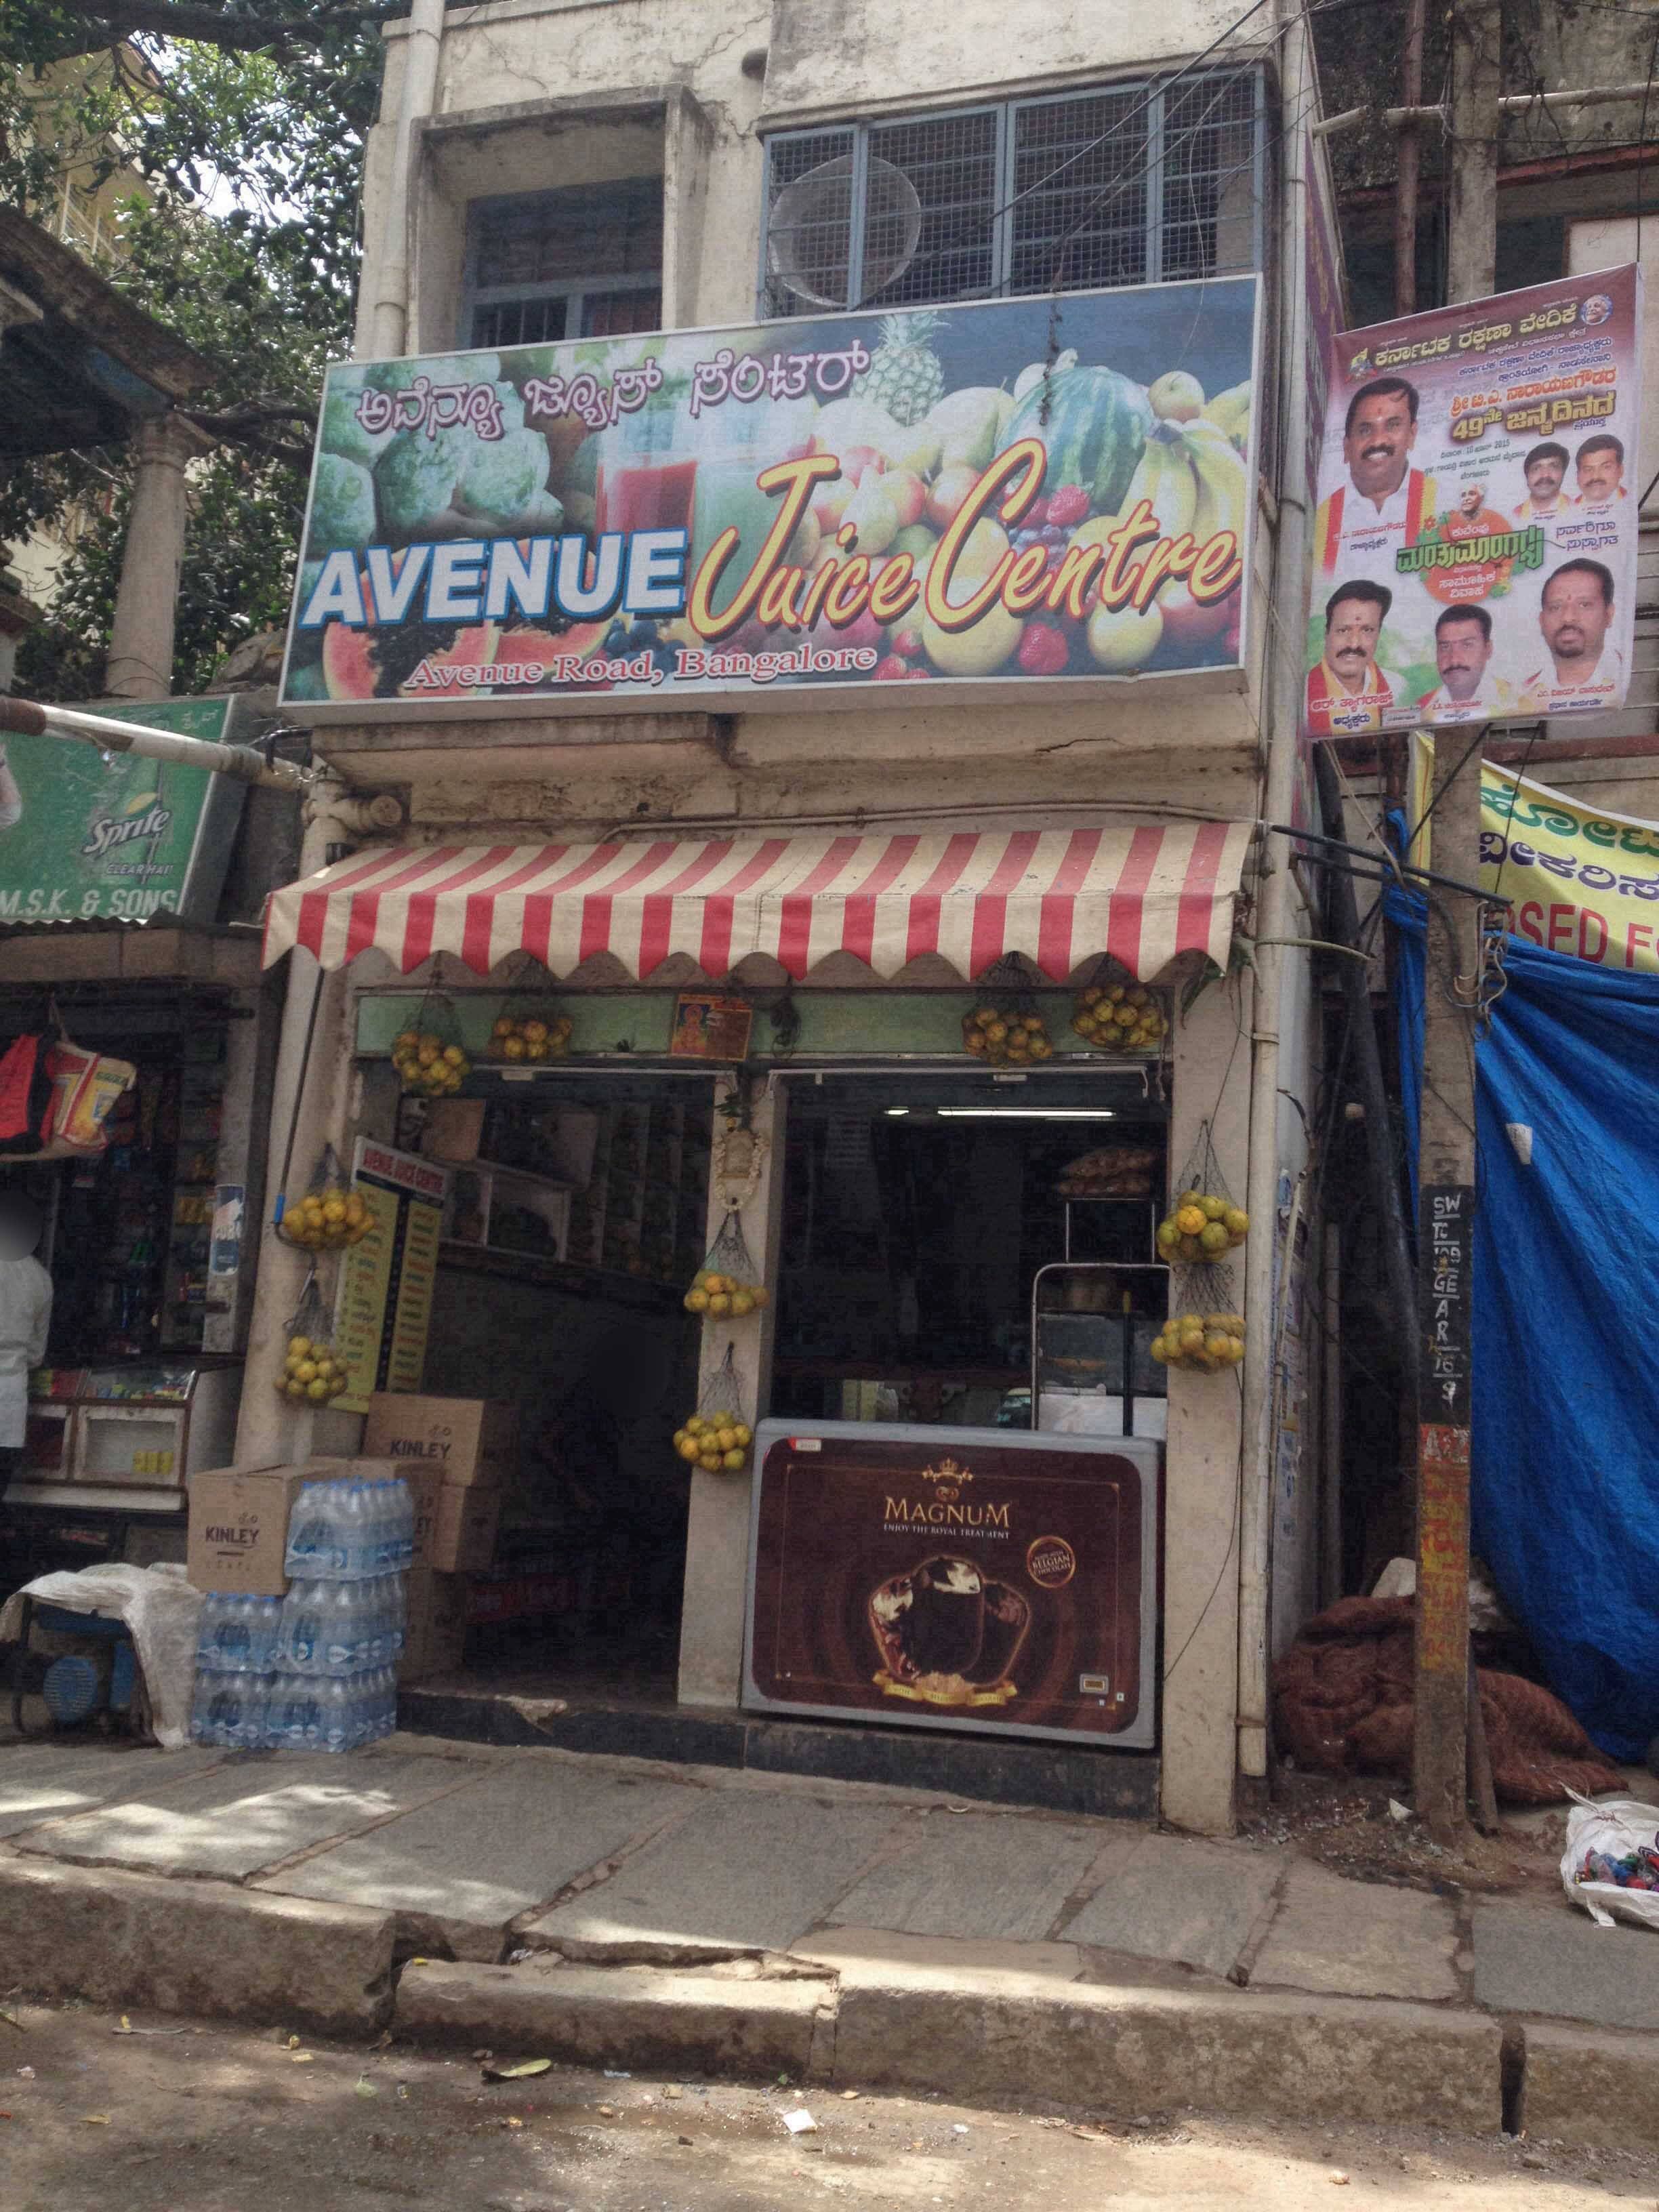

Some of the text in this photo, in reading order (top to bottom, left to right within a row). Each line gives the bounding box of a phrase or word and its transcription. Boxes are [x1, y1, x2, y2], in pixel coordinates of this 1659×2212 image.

[1375, 335, 1452, 366] ಕರ್ನಾಟಕ
[1458, 323, 1512, 352] ರಕ್ಷಣಾ
[1519, 303, 1578, 334] ವೇದಿಕೆ
[524, 357, 663, 432] ಜ್ಯೂಸ್
[690, 337, 871, 417] ಸೆಂಟರ್
[689, 437, 1244, 640] Juice Centre
[298, 527, 689, 630] AVENUE
[403, 646, 878, 690] Avenue Road, Bangalore
[82, 807, 171, 857] Sprite
[81, 889, 101, 916] &
[108, 888, 178, 916] SONS
[1505, 901, 1659, 968] SED F
[390, 1441, 451, 1460] KINLEY
[205, 1525, 260, 1544] KINLEY
[884, 1496, 1010, 1528] MAGNUM
[884, 1522, 909, 1532] ENJOY
[930, 1526, 957, 1537] ROYAL
